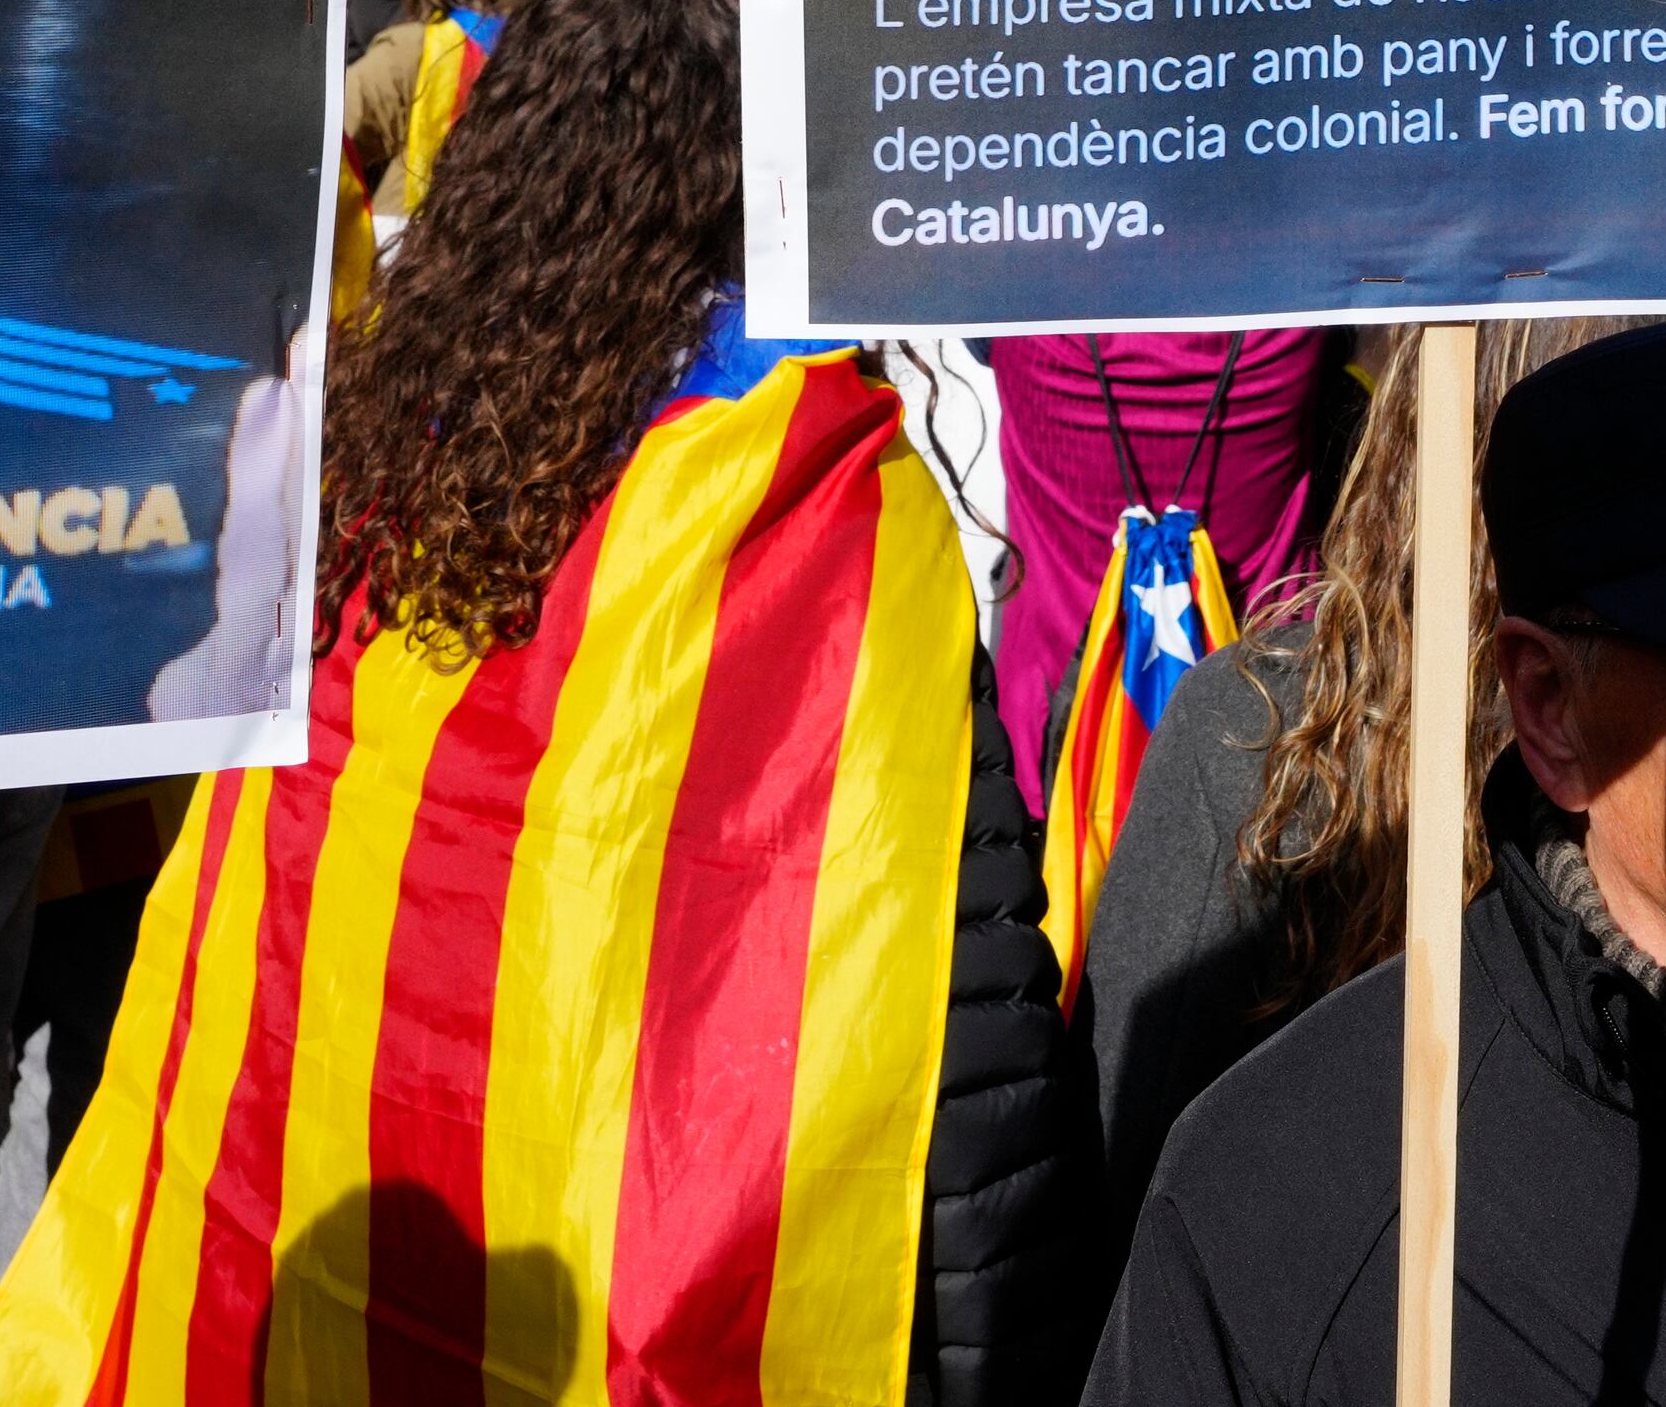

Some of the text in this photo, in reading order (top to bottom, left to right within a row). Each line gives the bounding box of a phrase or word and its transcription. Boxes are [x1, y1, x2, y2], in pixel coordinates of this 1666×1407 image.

[875, 51, 1045, 111] pretén
[1063, 51, 1236, 96] tancar
[1252, 34, 1364, 85] amb
[1383, 34, 1506, 86] pany
[1524, 24, 1535, 67] i
[873, 115, 1227, 181] dependència
[1244, 98, 1460, 155] colonial.
[1479, 93, 1585, 139] Fem
[870, 195, 1166, 250] Catalunya.
